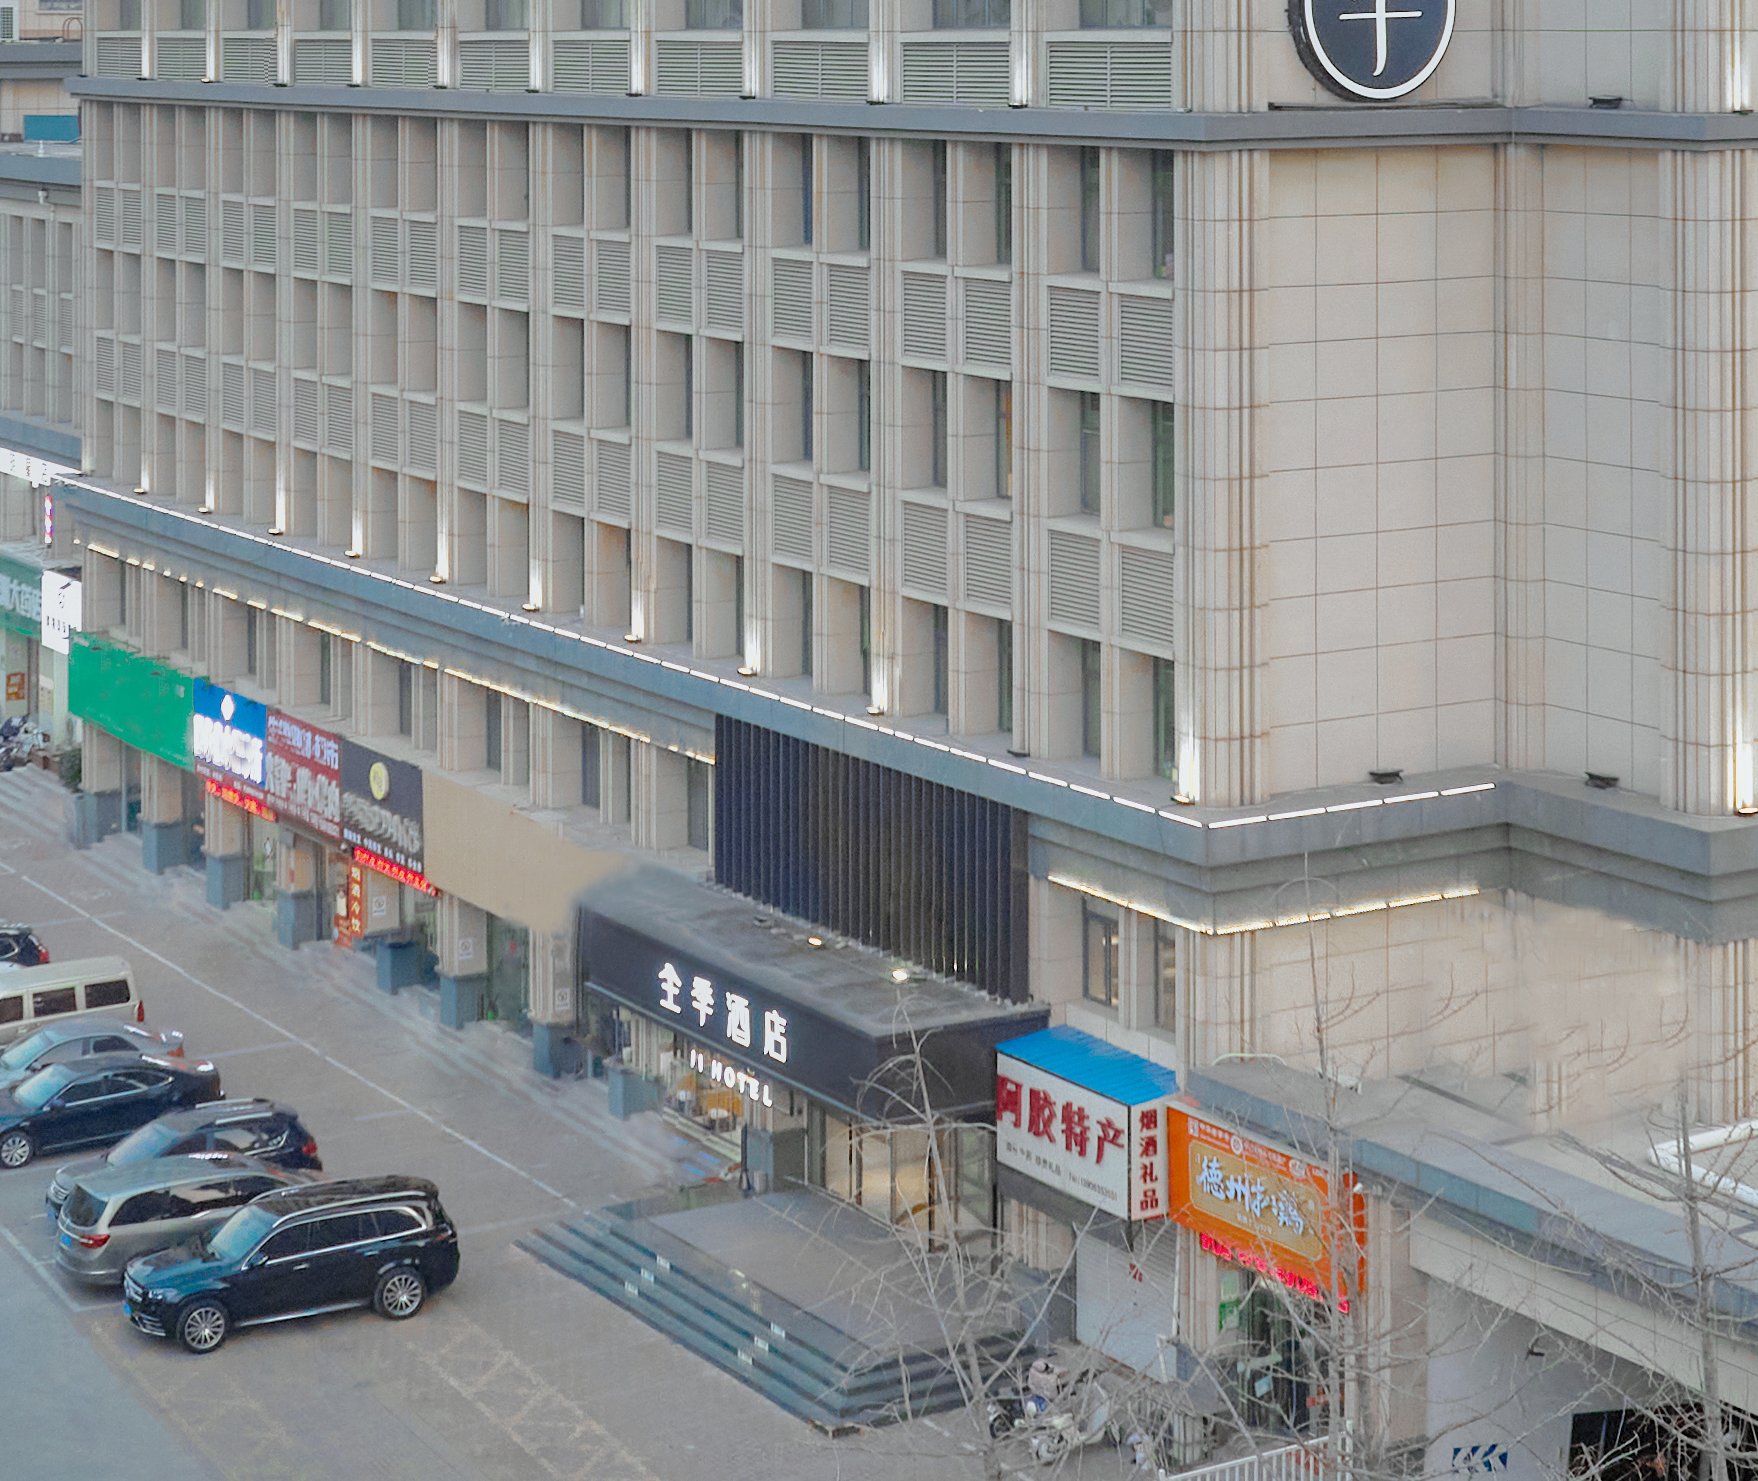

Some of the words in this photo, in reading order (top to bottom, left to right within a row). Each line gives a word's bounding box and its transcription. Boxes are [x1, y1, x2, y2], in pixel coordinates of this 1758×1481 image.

[658, 962, 788, 1064] 全季酒店
[711, 1059, 773, 1108] HOTEL
[997, 1074, 1125, 1165] 阿胶特产
[1139, 1108, 1159, 1212] 烟酒礼品
